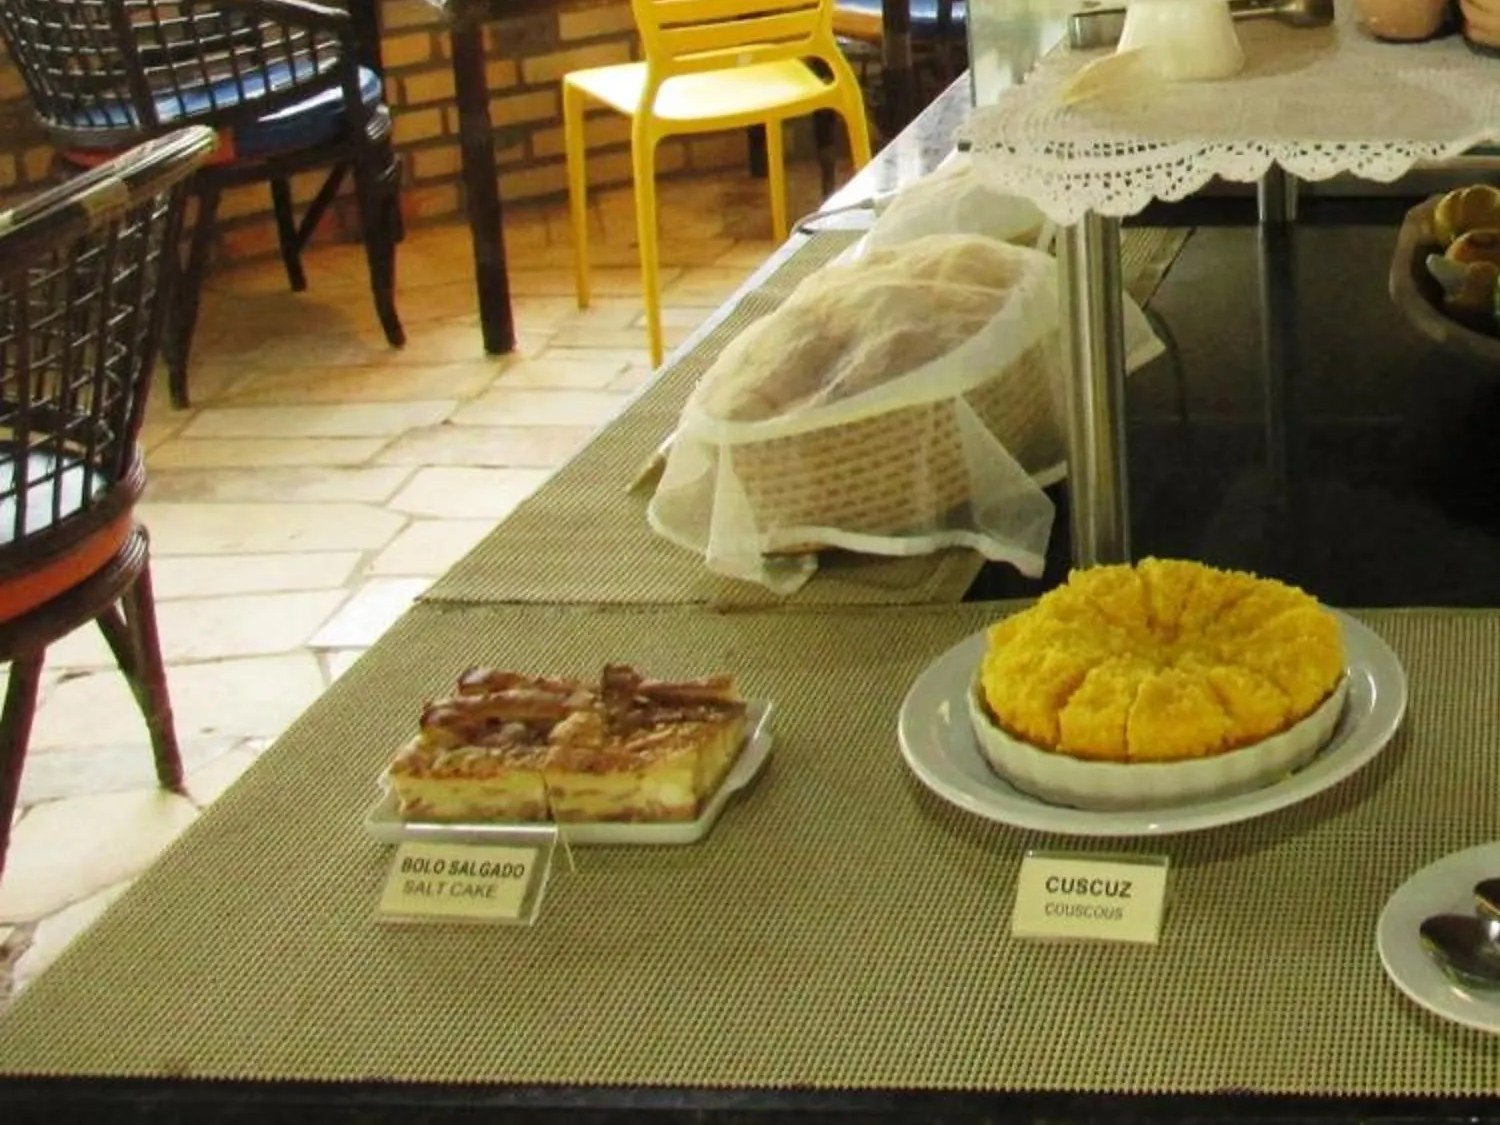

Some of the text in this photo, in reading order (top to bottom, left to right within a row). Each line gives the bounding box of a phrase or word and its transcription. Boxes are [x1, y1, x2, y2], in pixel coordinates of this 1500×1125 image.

[401, 856, 525, 879] BOLO SALGADO
[402, 879, 498, 899] SALT CAKE
[1045, 875, 1133, 898] CUSCUZ
[1044, 902, 1124, 920] COUSCOUS
